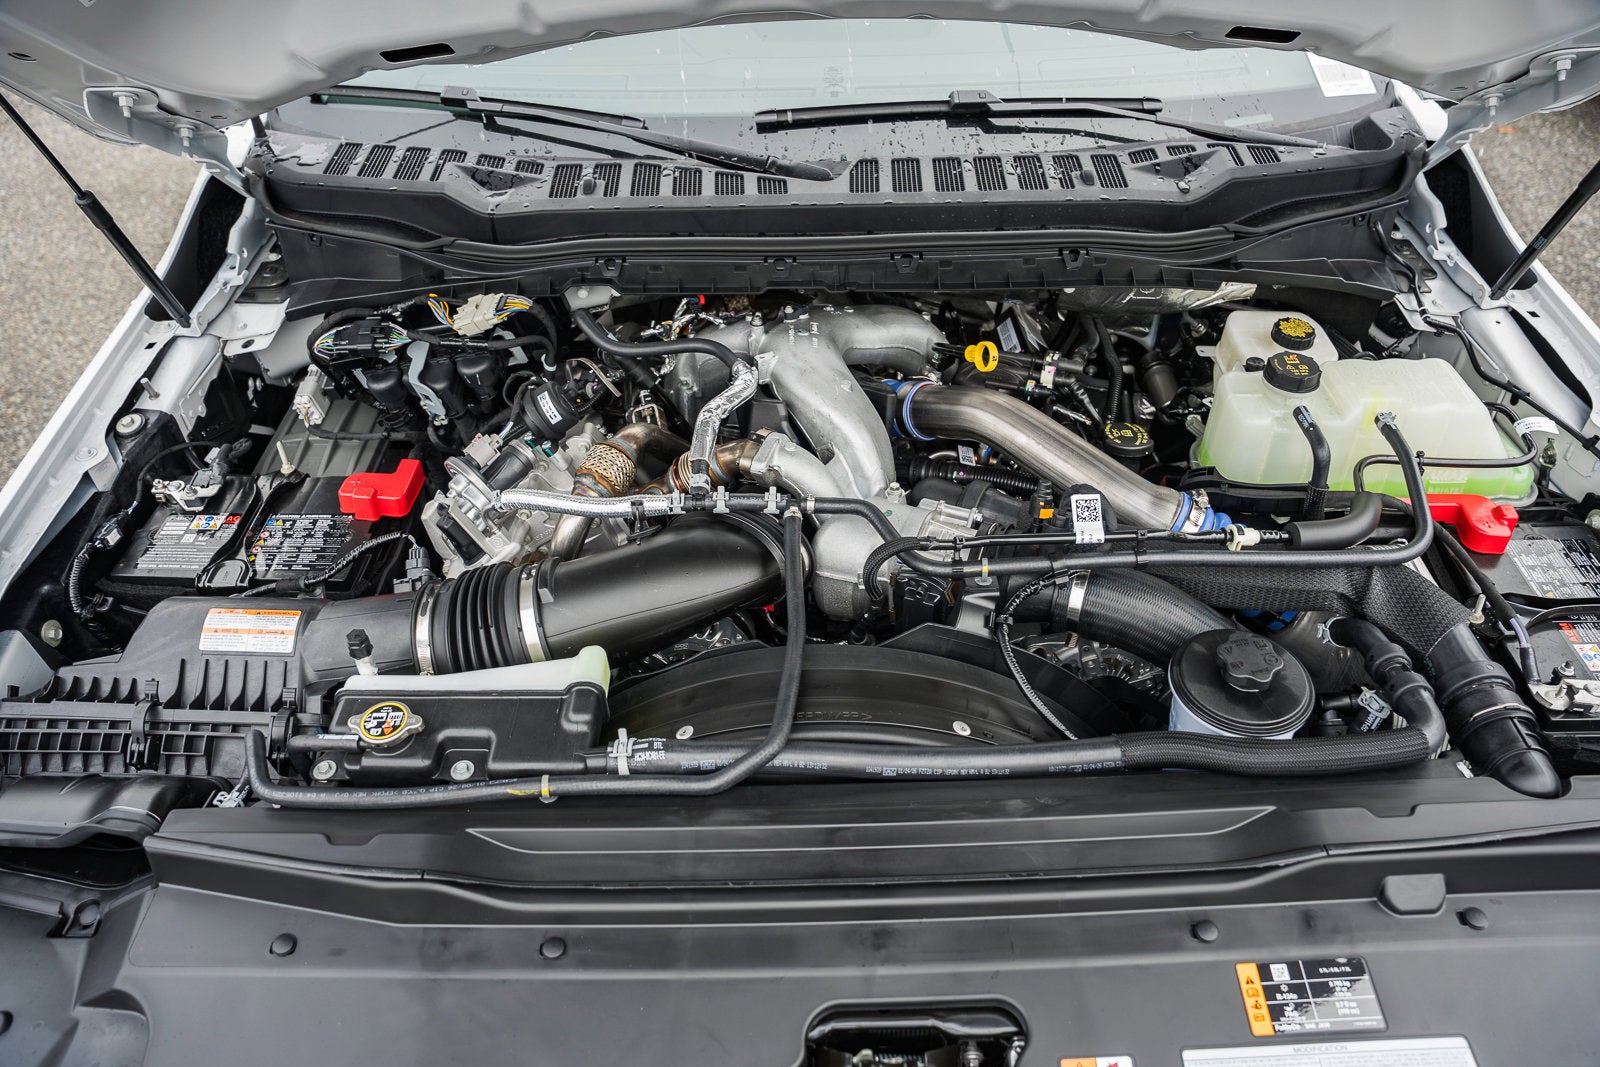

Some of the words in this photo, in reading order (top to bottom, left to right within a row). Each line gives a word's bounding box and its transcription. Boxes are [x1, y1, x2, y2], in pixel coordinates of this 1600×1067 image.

[1558, 622, 1583, 643] AGM
[653, 741, 664, 749] BTL
[1293, 1045, 1348, 1053] MODIFICATION
